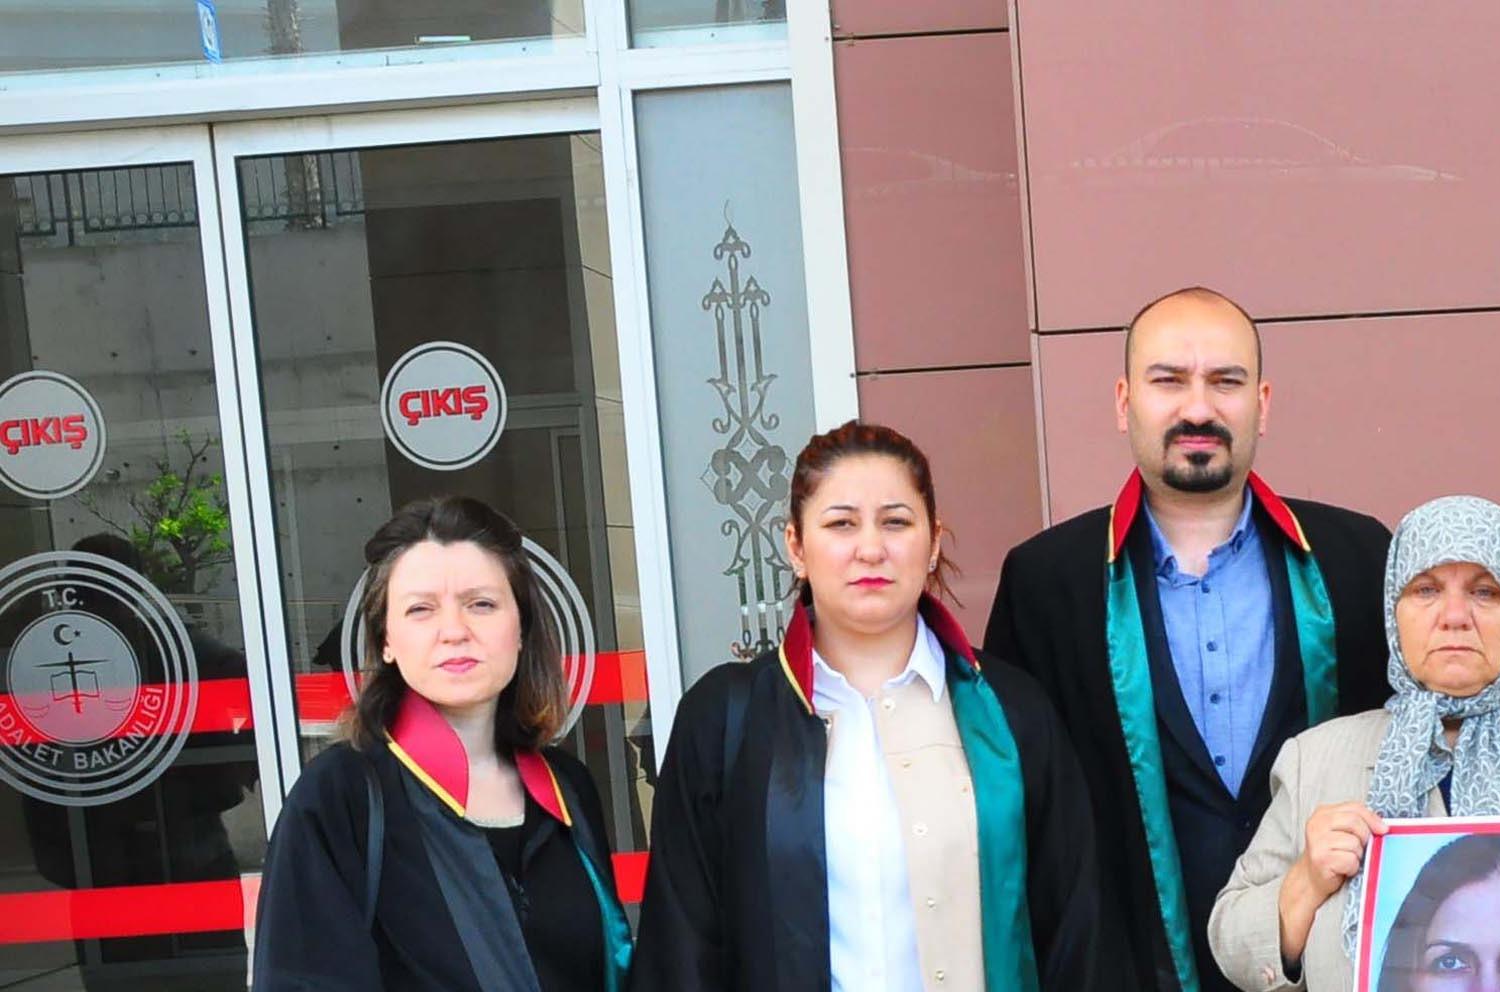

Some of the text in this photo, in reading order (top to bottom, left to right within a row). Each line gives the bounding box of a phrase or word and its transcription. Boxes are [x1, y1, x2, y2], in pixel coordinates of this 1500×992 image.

[400, 385, 490, 426] ÇIKIŞ
[0, 414, 88, 455] ÇIKIŞ
[42, 587, 84, 607] T.C.
[73, 687, 163, 770] BAKANLIĞI
